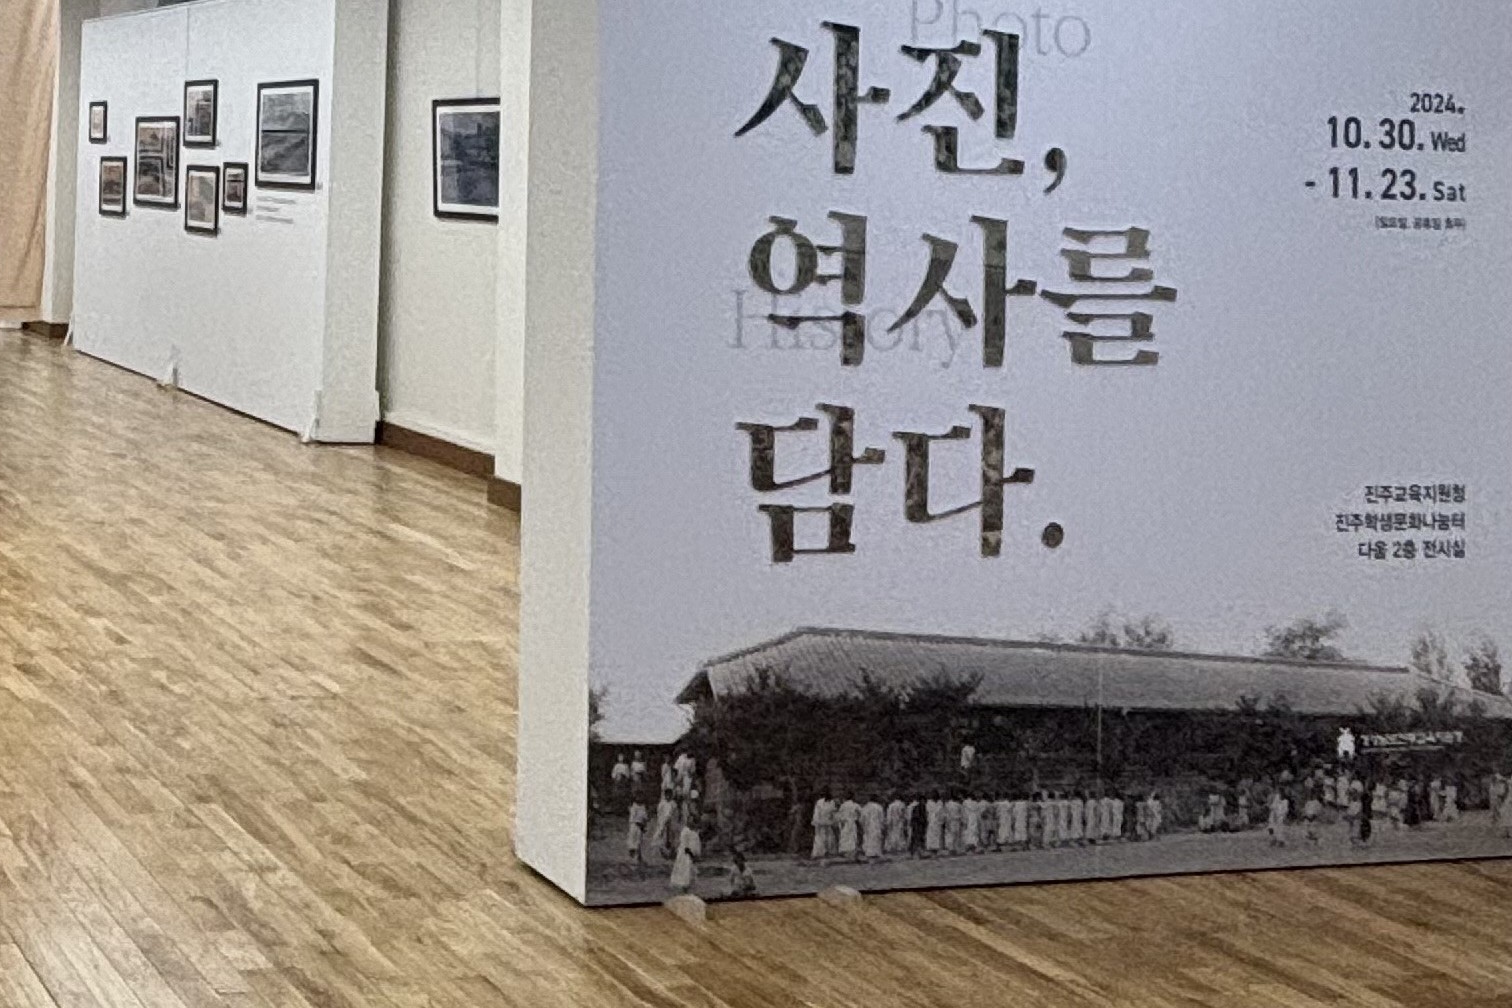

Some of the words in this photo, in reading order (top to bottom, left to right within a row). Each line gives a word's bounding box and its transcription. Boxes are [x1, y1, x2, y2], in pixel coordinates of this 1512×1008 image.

[734, 20, 1067, 194] 사진,
[1409, 91, 1466, 115] 2024.
[1430, 131, 1466, 153] Wed
[1432, 180, 1467, 202] Sat
[748, 210, 1178, 369] 역사를
[728, 290, 958, 369] Hisory
[736, 403, 1065, 564] 담다.
[1364, 483, 1466, 504] 진주교육지원청
[1335, 512, 1466, 533] 진주학생문화나눔터
[1422, 539, 1466, 559] 전시실
